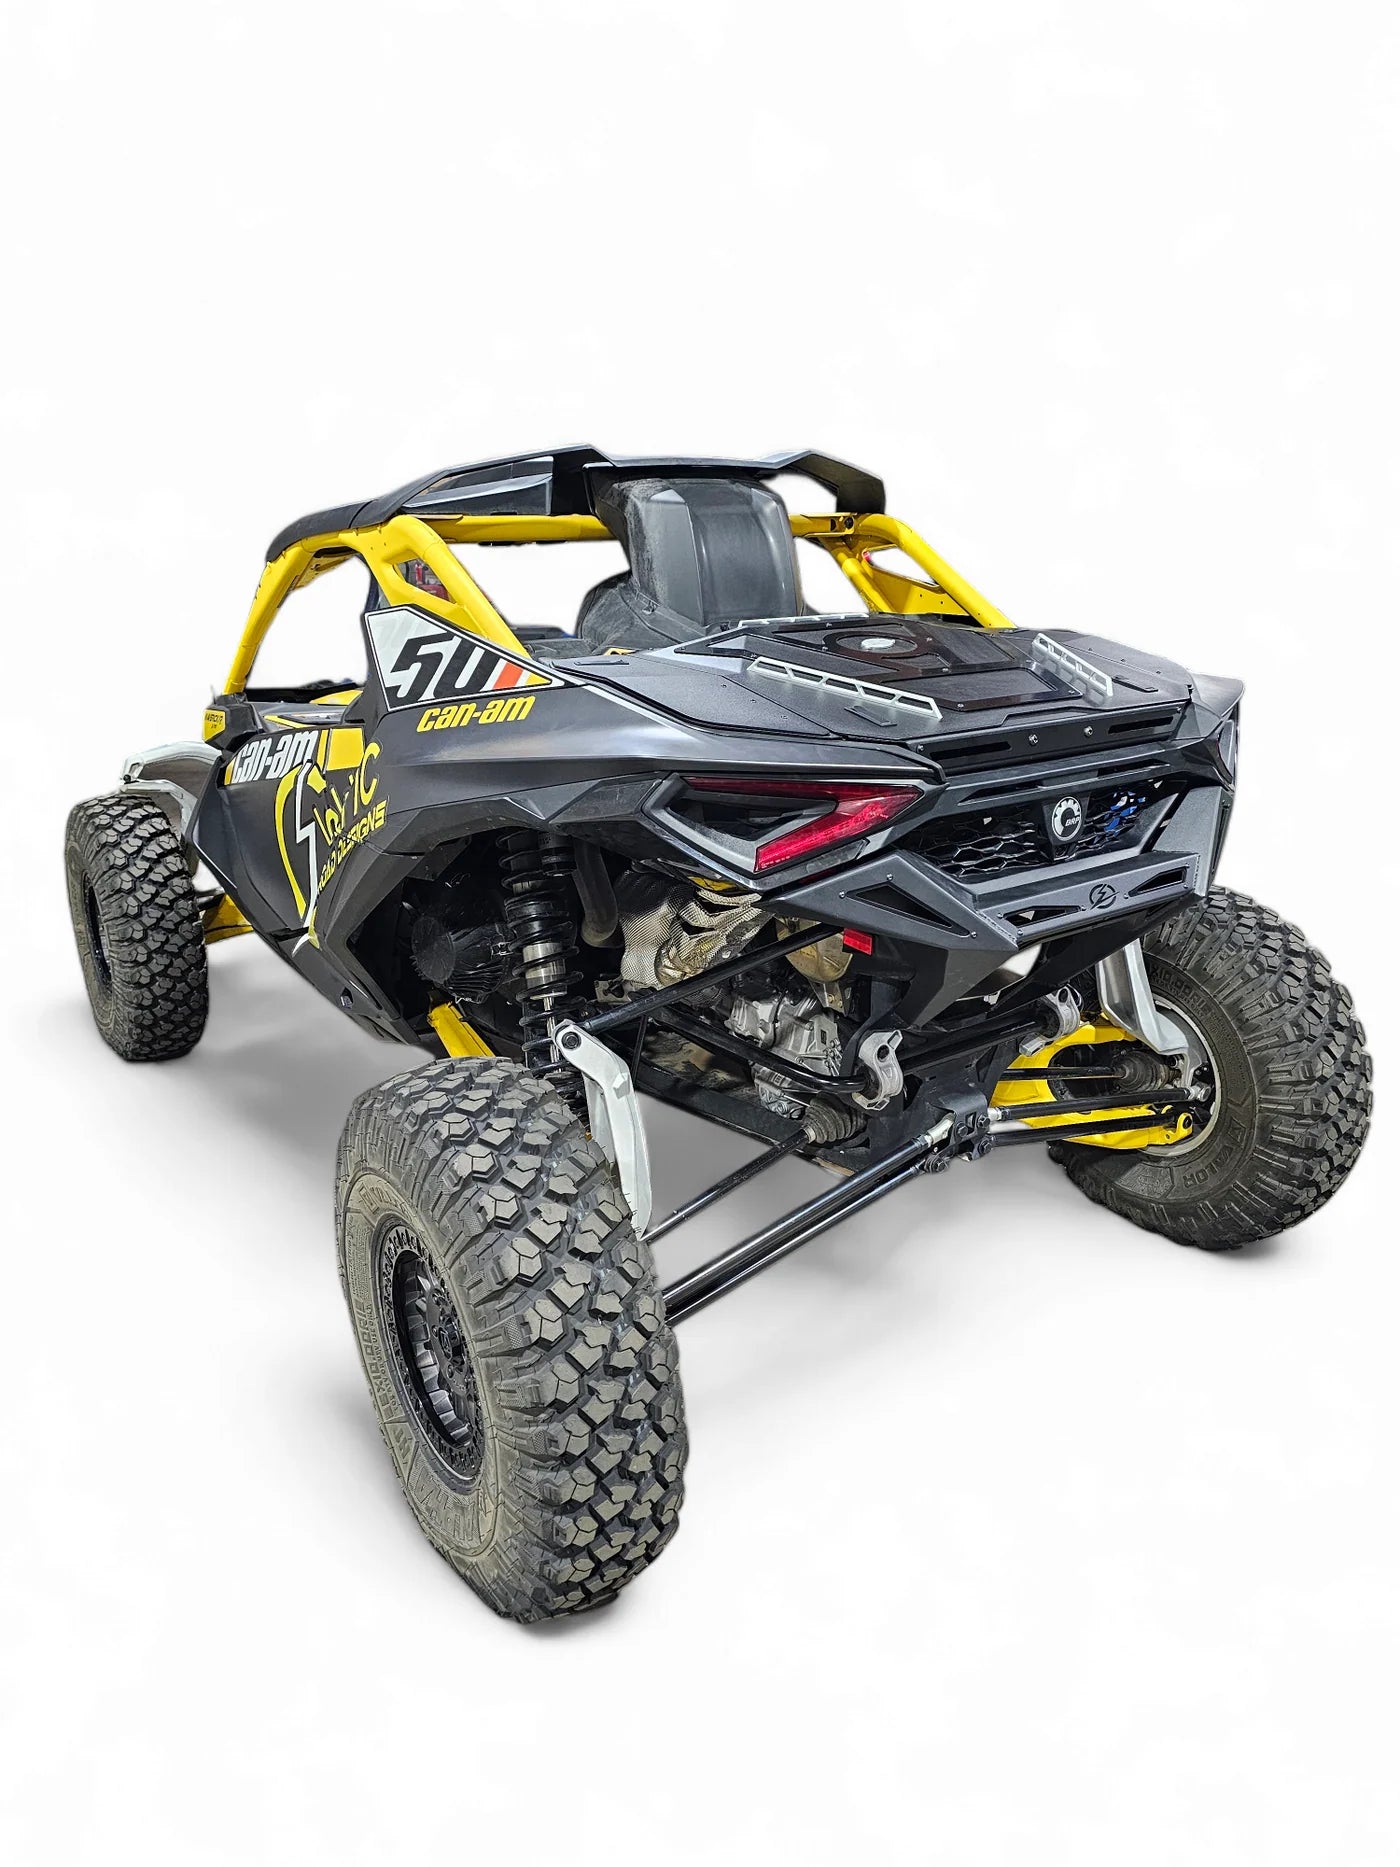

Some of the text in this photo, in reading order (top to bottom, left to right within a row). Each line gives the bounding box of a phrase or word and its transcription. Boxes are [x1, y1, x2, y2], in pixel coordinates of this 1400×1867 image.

[416, 695, 536, 733] can-am
[232, 730, 319, 784] can-am
[1065, 816, 1081, 827] BRP
